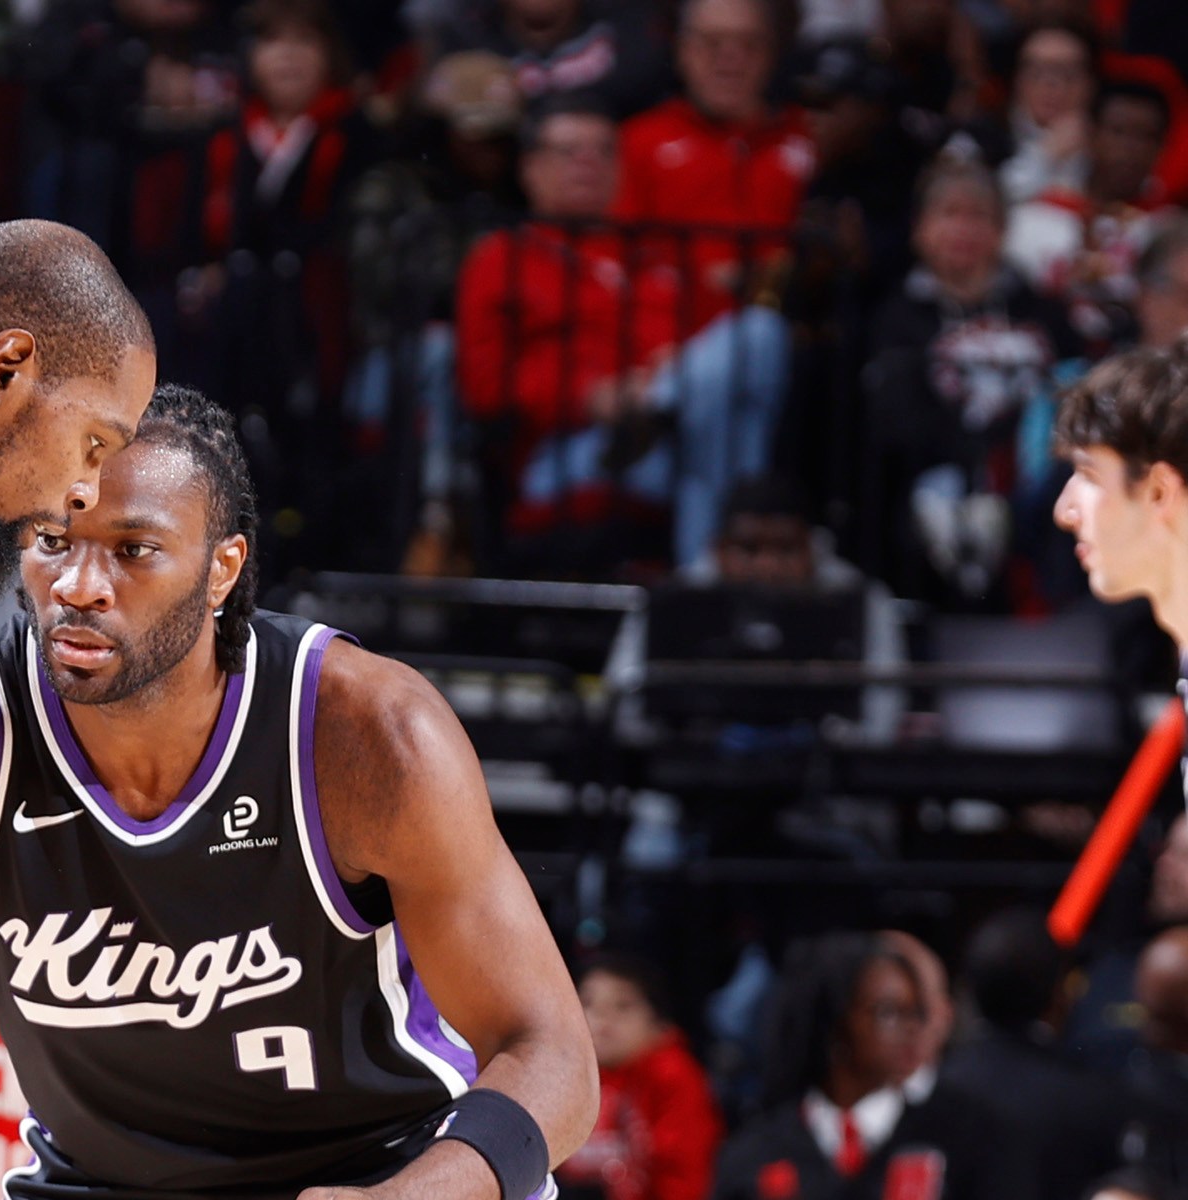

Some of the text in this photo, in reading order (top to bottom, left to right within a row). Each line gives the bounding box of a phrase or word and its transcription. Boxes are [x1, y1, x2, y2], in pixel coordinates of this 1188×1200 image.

[209, 837, 279, 855] PHOONG LAW
[232, 1025, 318, 1091] 9
